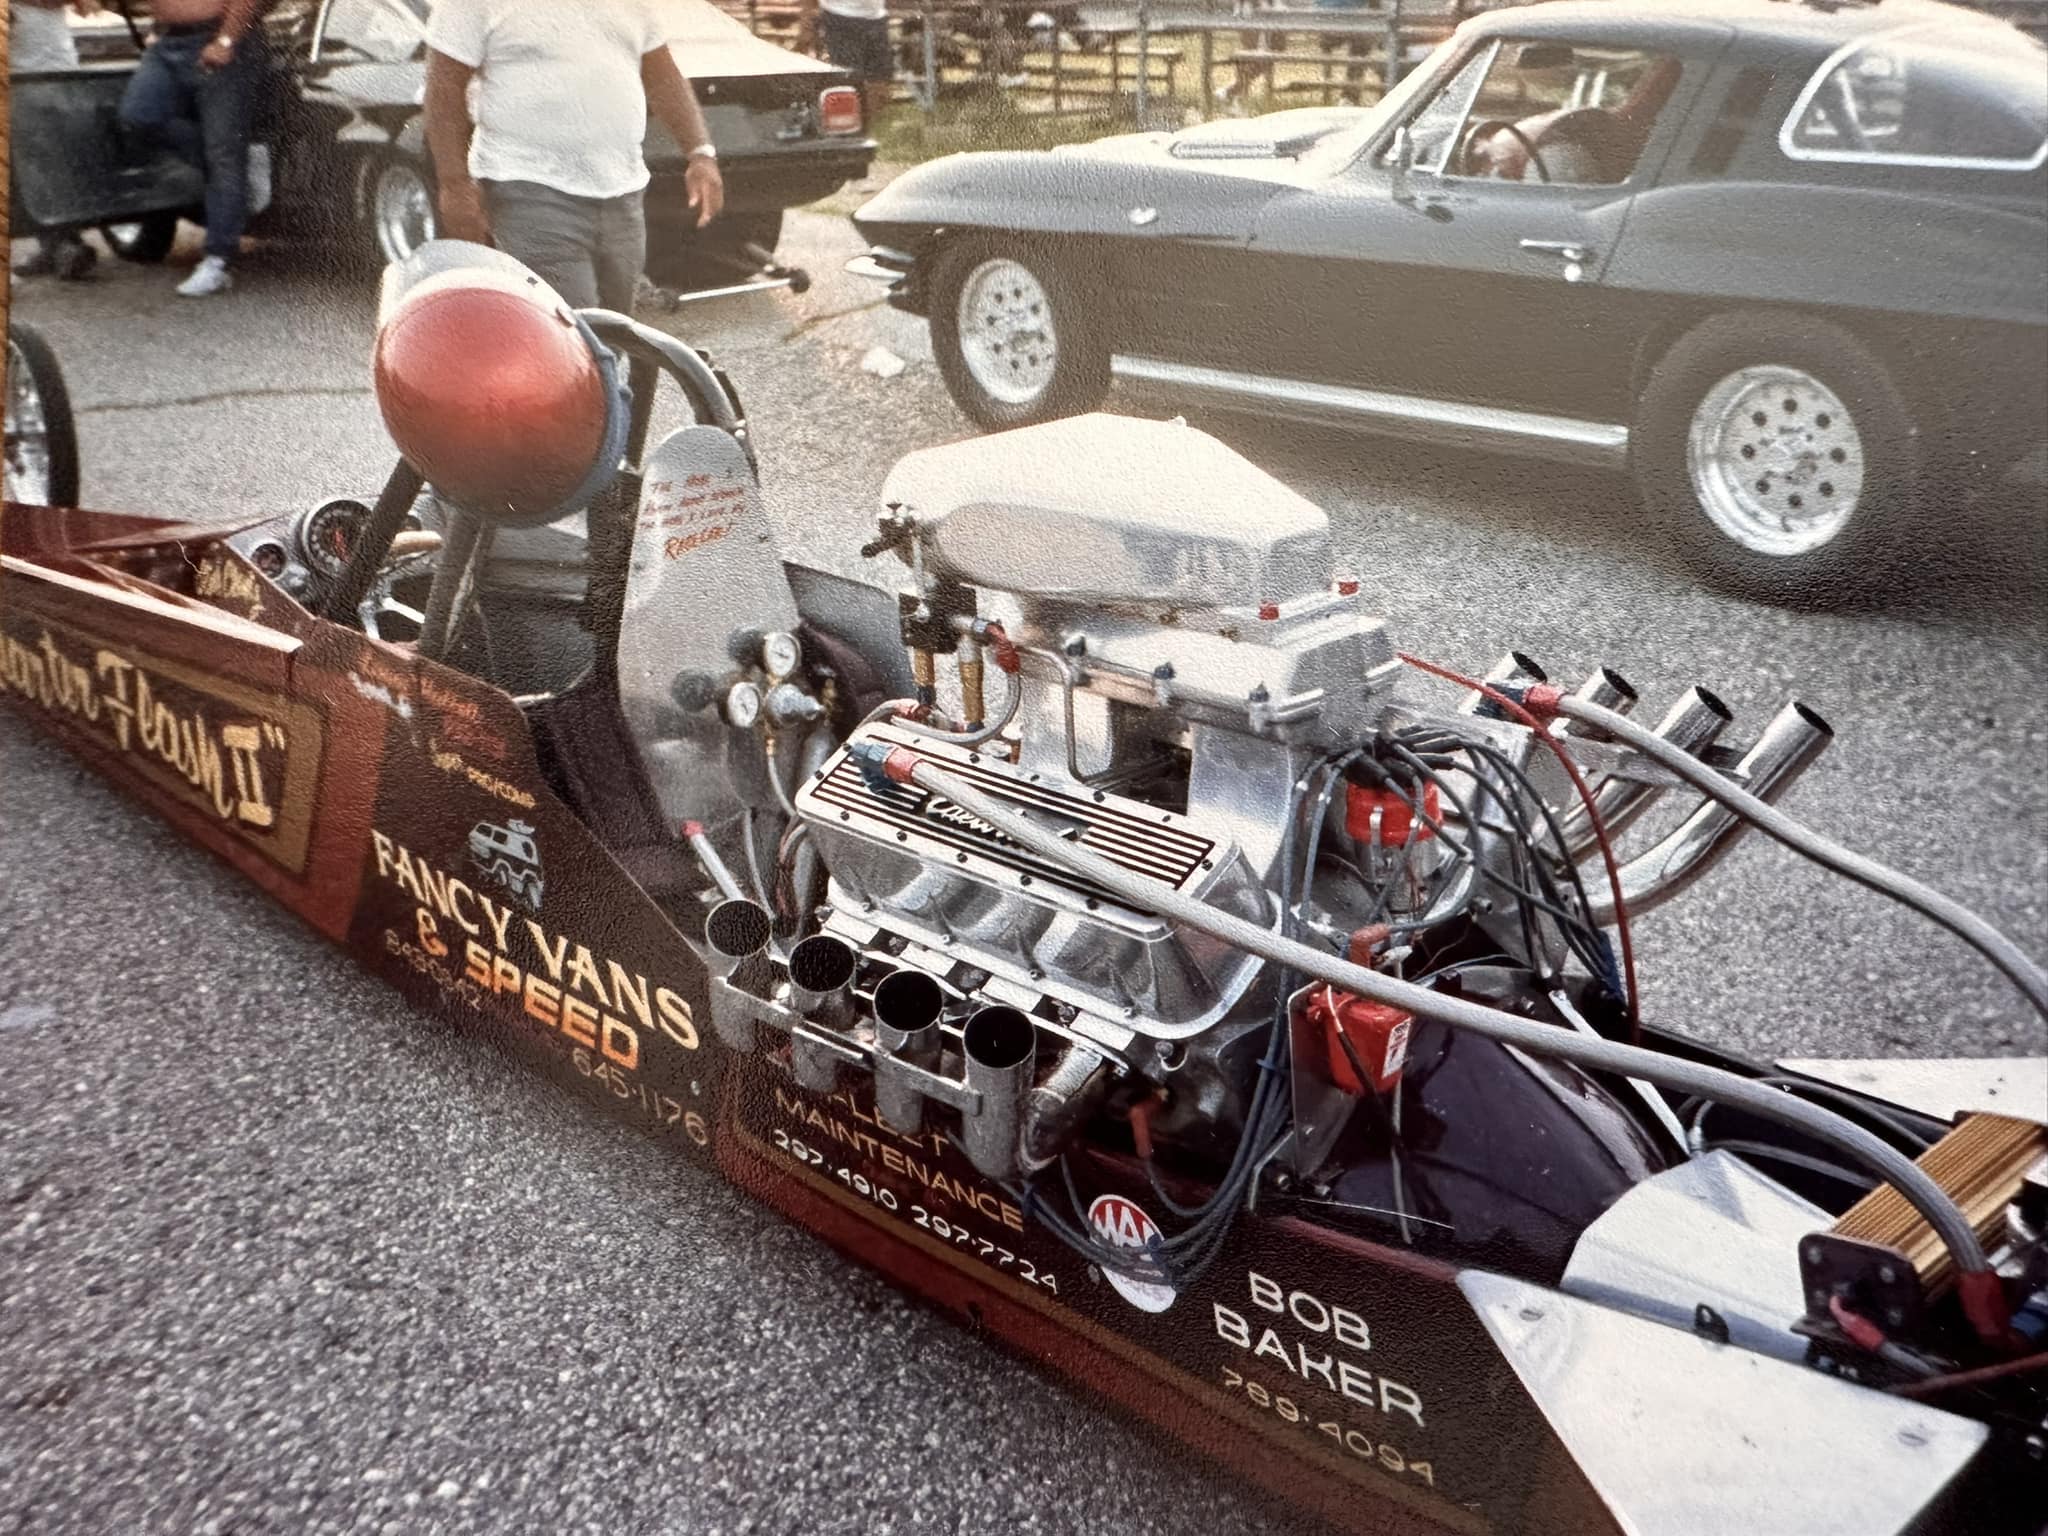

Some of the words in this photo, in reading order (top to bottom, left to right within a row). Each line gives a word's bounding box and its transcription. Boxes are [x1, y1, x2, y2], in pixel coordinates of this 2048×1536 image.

[97, 651, 234, 819] Flash
[371, 829, 512, 951] FANCY
[527, 918, 700, 1049] VANS
[416, 908, 449, 957] &
[464, 938, 640, 1071] SPEED
[776, 1088, 1024, 1233] MAINTENANCE
[1213, 1302, 1426, 1428] BAKER
[1249, 1271, 1372, 1351] BOB
